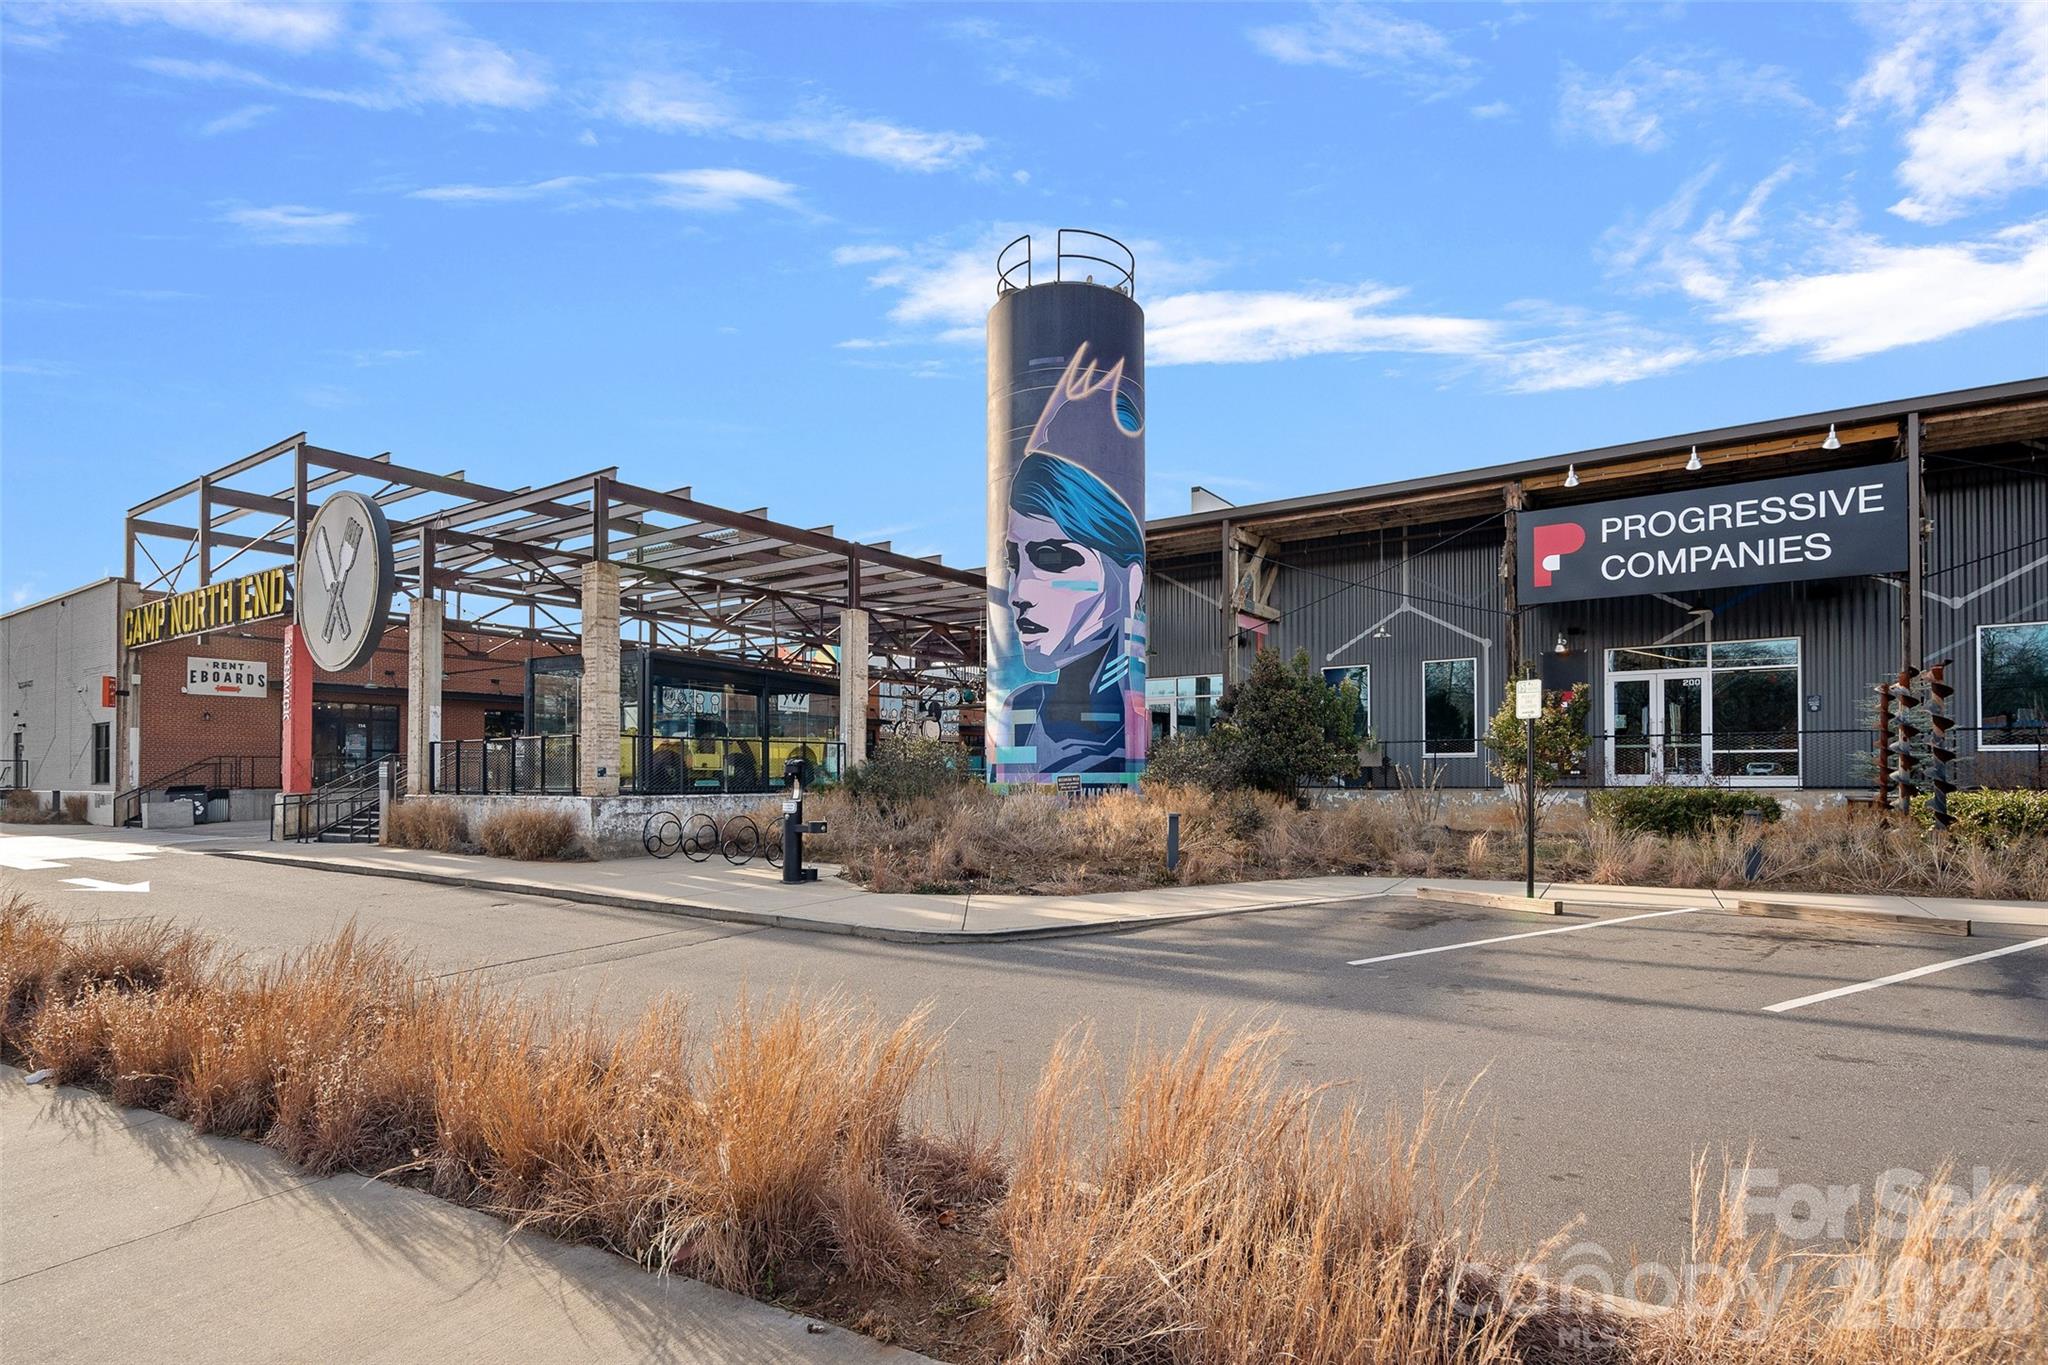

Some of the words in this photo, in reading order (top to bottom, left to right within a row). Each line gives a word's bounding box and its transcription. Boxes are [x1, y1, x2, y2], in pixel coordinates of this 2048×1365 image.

[1601, 483, 1884, 543] PROGRESSIVE
[1601, 532, 1832, 581] COMPANIES
[123, 600, 166, 647] CAMP
[170, 581, 233, 636] NORTH
[240, 568, 285, 620] END
[190, 670, 265, 687] EBOARDS
[212, 661, 244, 670] RENT
[1682, 679, 1701, 687] 200
